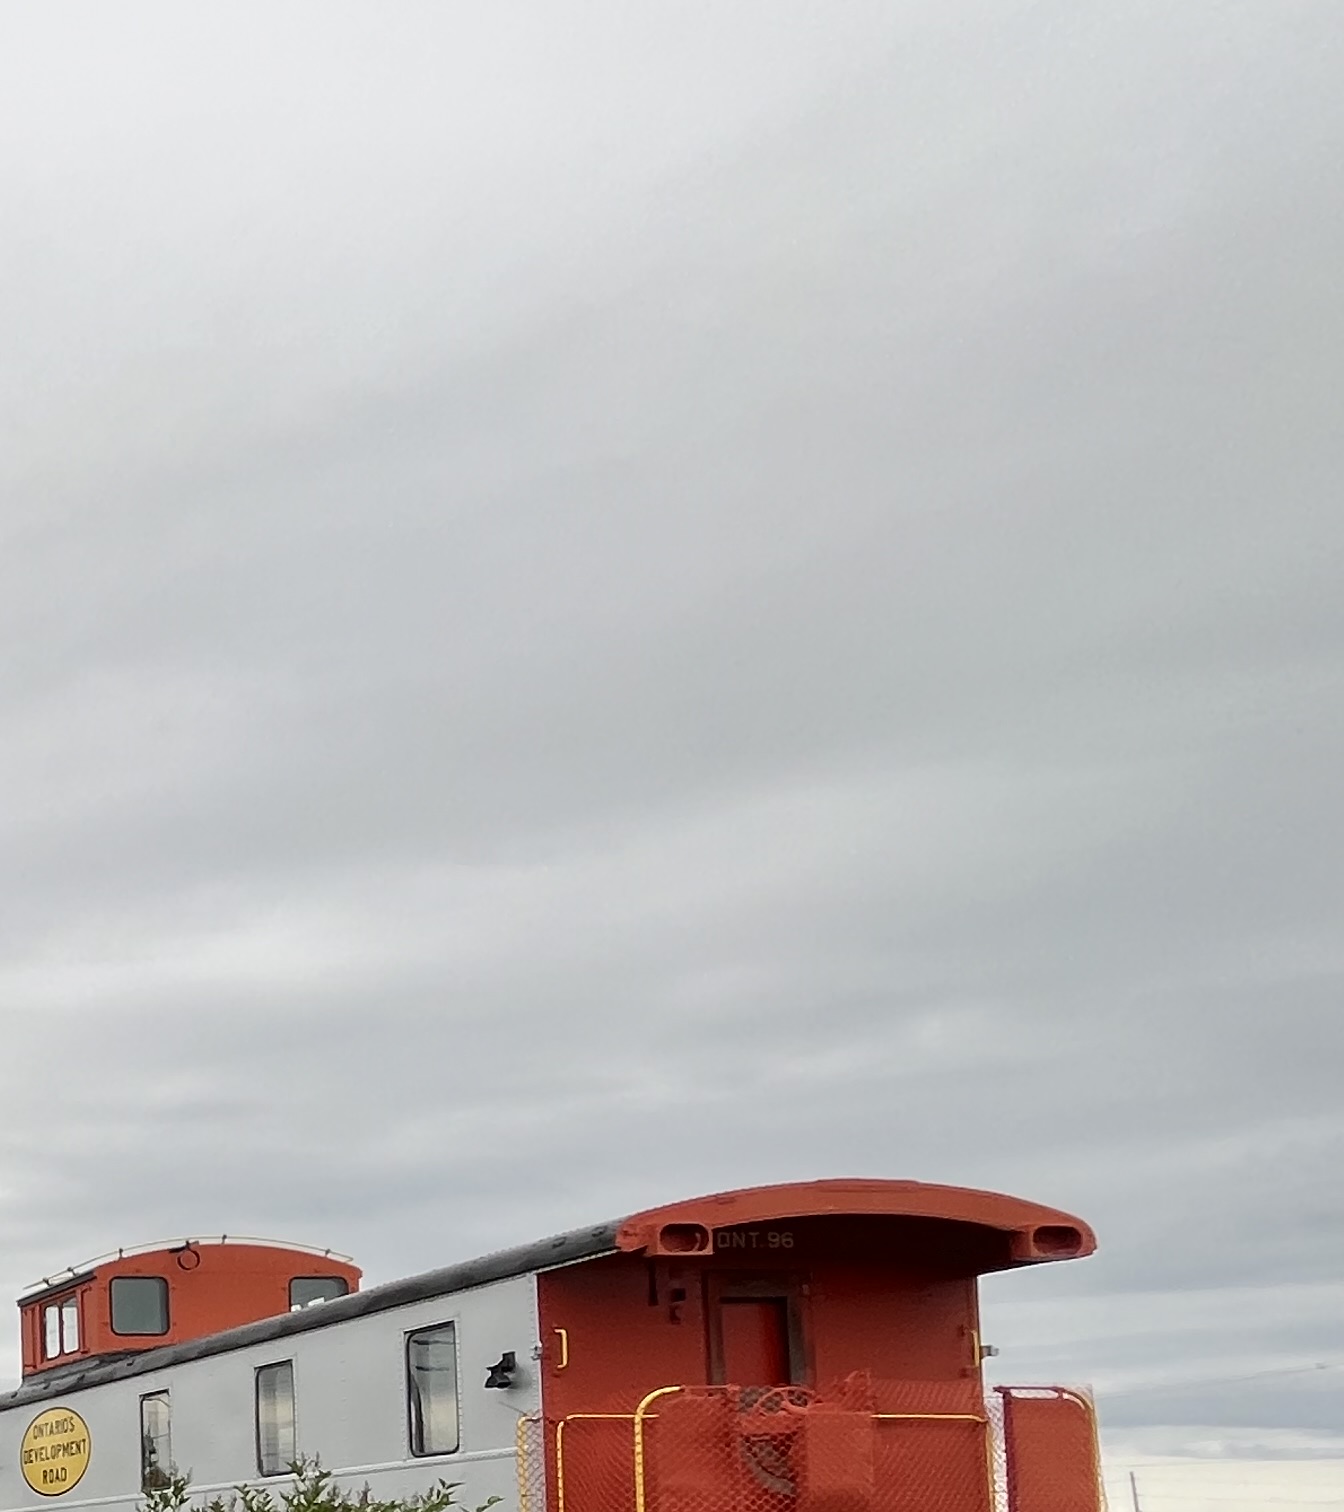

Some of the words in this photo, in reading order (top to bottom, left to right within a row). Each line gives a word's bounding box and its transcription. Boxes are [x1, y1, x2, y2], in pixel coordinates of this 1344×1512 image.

[33, 1416, 76, 1440] ONTARIO'S
[23, 1438, 87, 1465] DEVELOPMENT
[42, 1466, 68, 1485] ROAD
